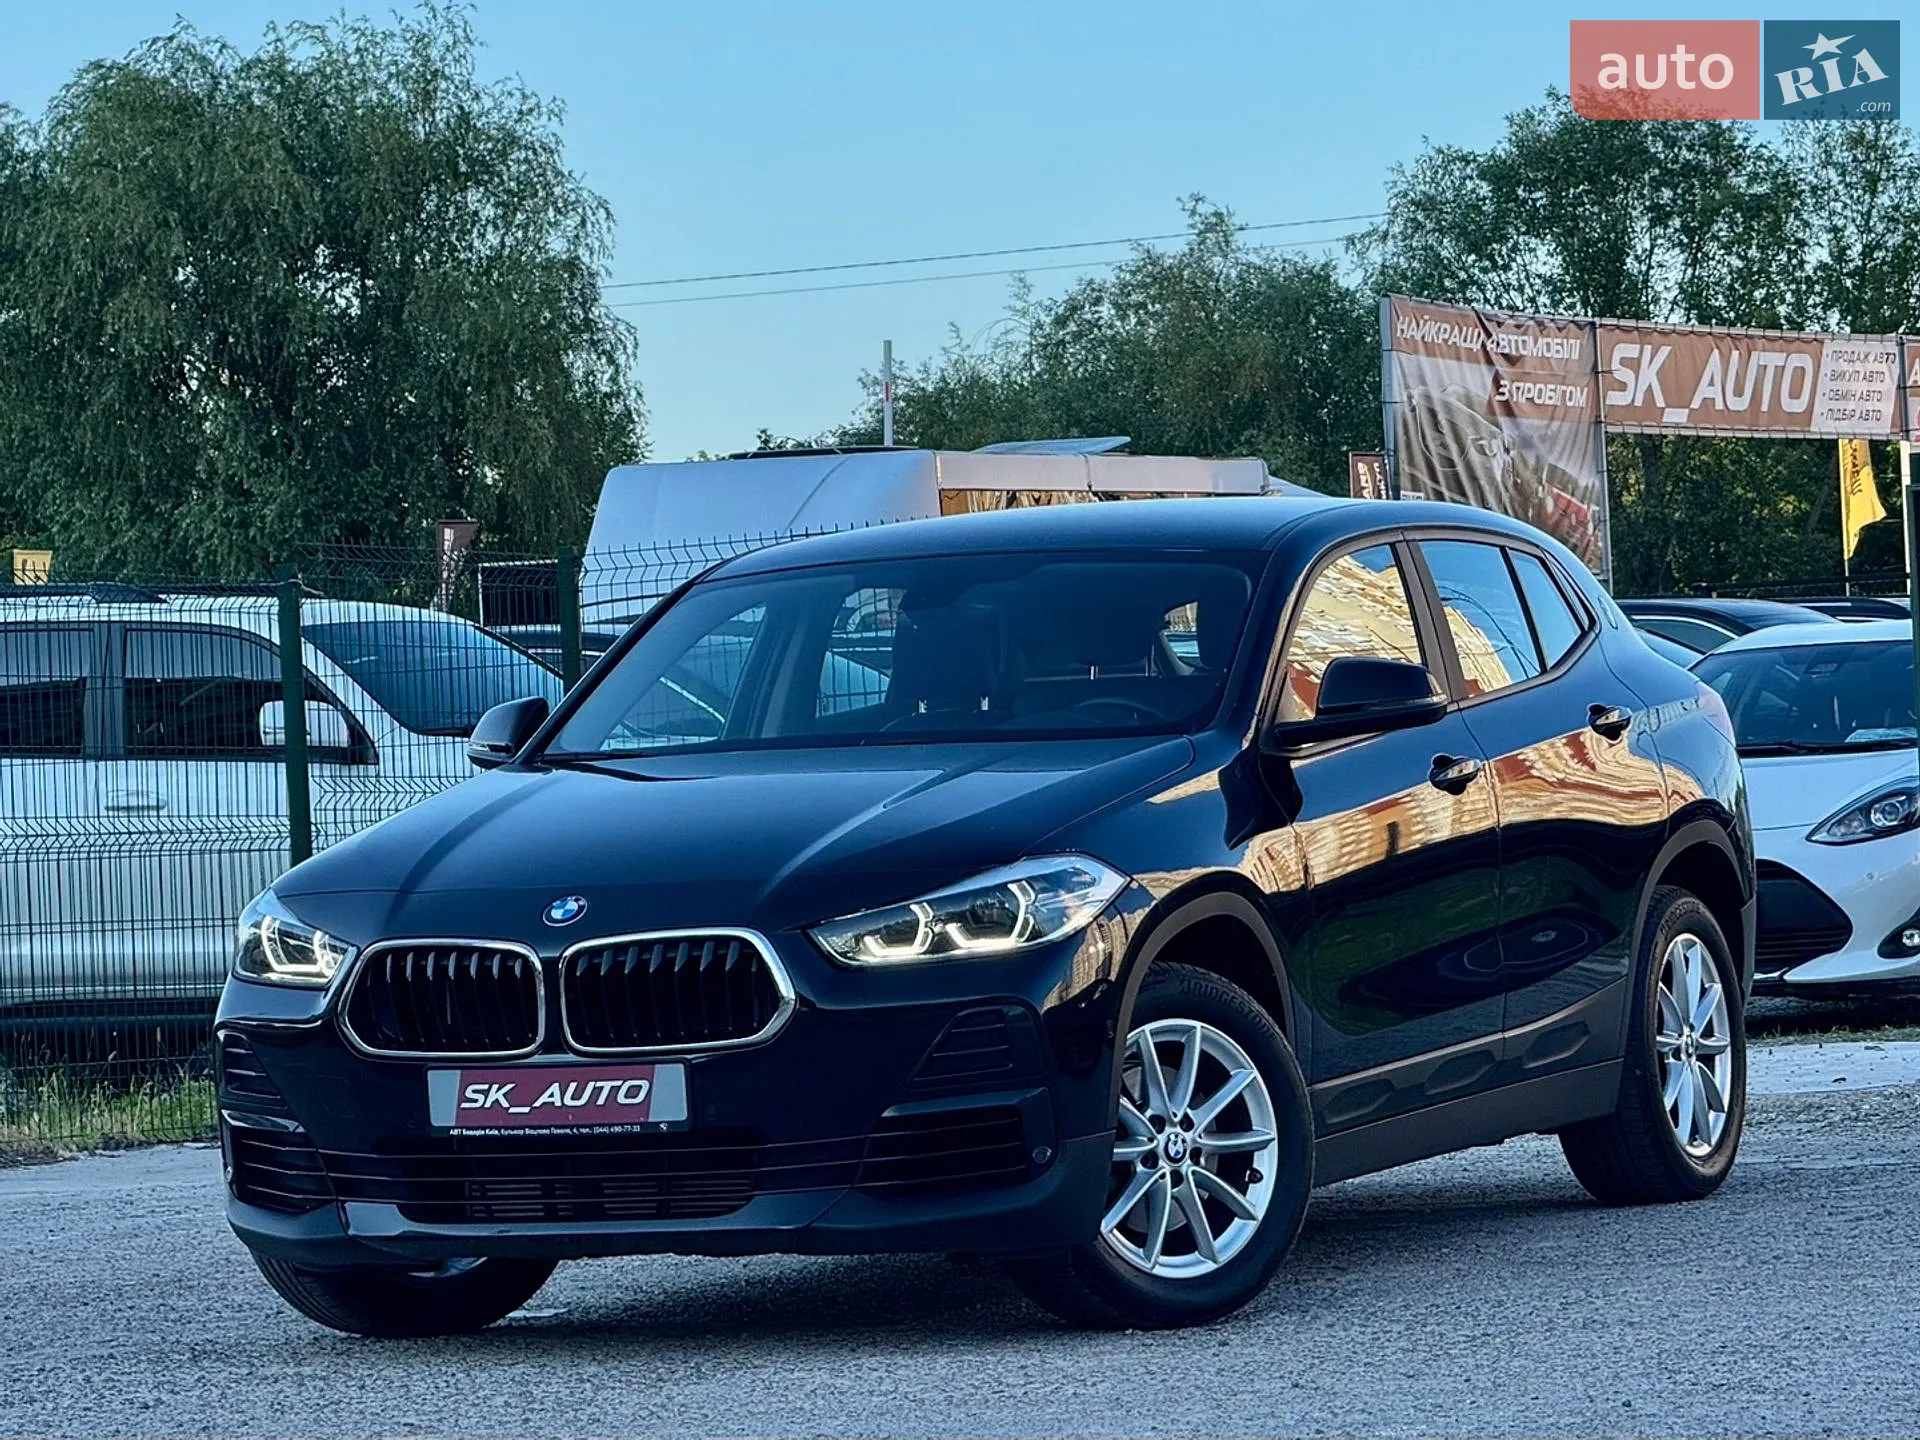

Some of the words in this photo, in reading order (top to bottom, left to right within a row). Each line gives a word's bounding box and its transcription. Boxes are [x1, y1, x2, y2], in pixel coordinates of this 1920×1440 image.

[1397, 315, 1484, 352] НАЙКРАЩІ
[1487, 331, 1580, 361] АВТОМОБІЛІ
[1830, 350, 1871, 365] ПРОДАЖ
[1872, 352, 1897, 364] АВТО
[1606, 343, 1814, 423] SK_AUTO
[1829, 369, 1861, 382] ВИКУП
[1862, 370, 1886, 383] АВТО
[1495, 380, 1509, 401] З
[1512, 382, 1588, 408] ПРОБІГОМ
[1828, 389, 1858, 401] ОБМІН
[1859, 390, 1883, 403] АВТО
[1826, 408, 1856, 421] ПІДБІР
[1857, 409, 1883, 422] АВТО
[459, 1078, 651, 1114] SK_AUTO
